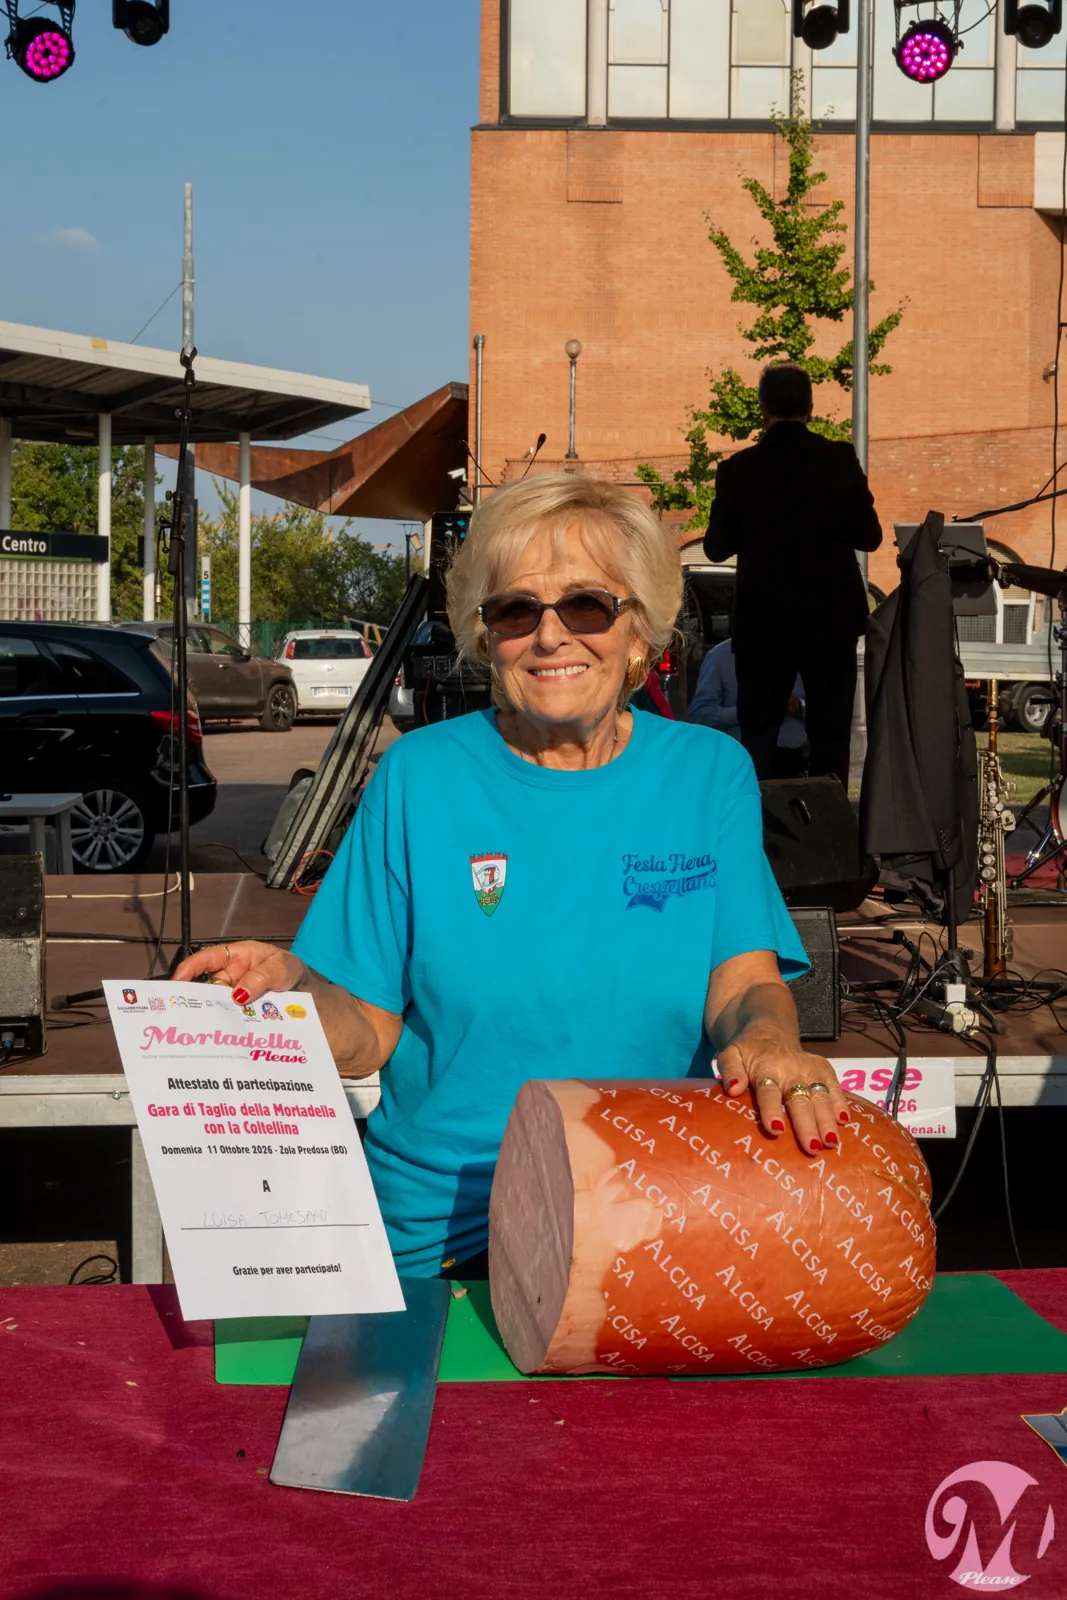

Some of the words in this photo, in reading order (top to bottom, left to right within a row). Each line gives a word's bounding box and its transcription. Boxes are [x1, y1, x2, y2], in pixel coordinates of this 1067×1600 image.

[2, 535, 47, 553] Centro
[203, 570, 209, 580] 5
[668, 853, 711, 874] Fiera
[249, 1049, 308, 1064] Please
[167, 1077, 220, 1090] Attestato
[222, 1077, 234, 1090] di
[236, 1078, 314, 1092] partecipazione
[839, 1067, 923, 1092] ase
[147, 1103, 180, 1117] Gara
[183, 1102, 196, 1116] di
[197, 1102, 237, 1118] Taglio
[240, 1102, 271, 1117] della
[272, 1103, 337, 1118] Mortadella
[694, 1087, 762, 1124] ALCIS
[204, 1123, 226, 1135] con
[227, 1120, 241, 1135] la
[243, 1120, 299, 1135] Coltellina
[600, 1108, 657, 1155] LCISA
[161, 1145, 203, 1155] Domenica
[207, 1145, 218, 1154] 11
[220, 1145, 251, 1155] Ottobre
[251, 1145, 273, 1155] 2026
[279, 1145, 297, 1155] Zola
[298, 1145, 330, 1155] Predosa
[330, 1145, 348, 1155] (BO)
[658, 1114, 732, 1179] ALCISA
[262, 1179, 272, 1193] A
[734, 1134, 805, 1206] ALCISA
[618, 1158, 687, 1234] ALCISA
[808, 1158, 874, 1232] ALCISA
[203, 1211, 248, 1228] LUISA
[692, 1183, 759, 1260] ALCISA
[877, 1185, 926, 1248] ALCISA
[765, 1210, 829, 1285] ALCISA
[232, 1265, 260, 1276] Grazie
[260, 1266, 274, 1276] per
[276, 1265, 293, 1275] aver
[295, 1262, 343, 1275] partecipato!
[643, 1238, 707, 1311] ALCISA
[836, 1236, 892, 1302] ALCISA
[716, 1264, 774, 1331] ALCISA
[784, 1289, 839, 1345] ALCISA
[660, 1314, 716, 1362] ALCISA
[727, 1333, 779, 1370] ALCISA
